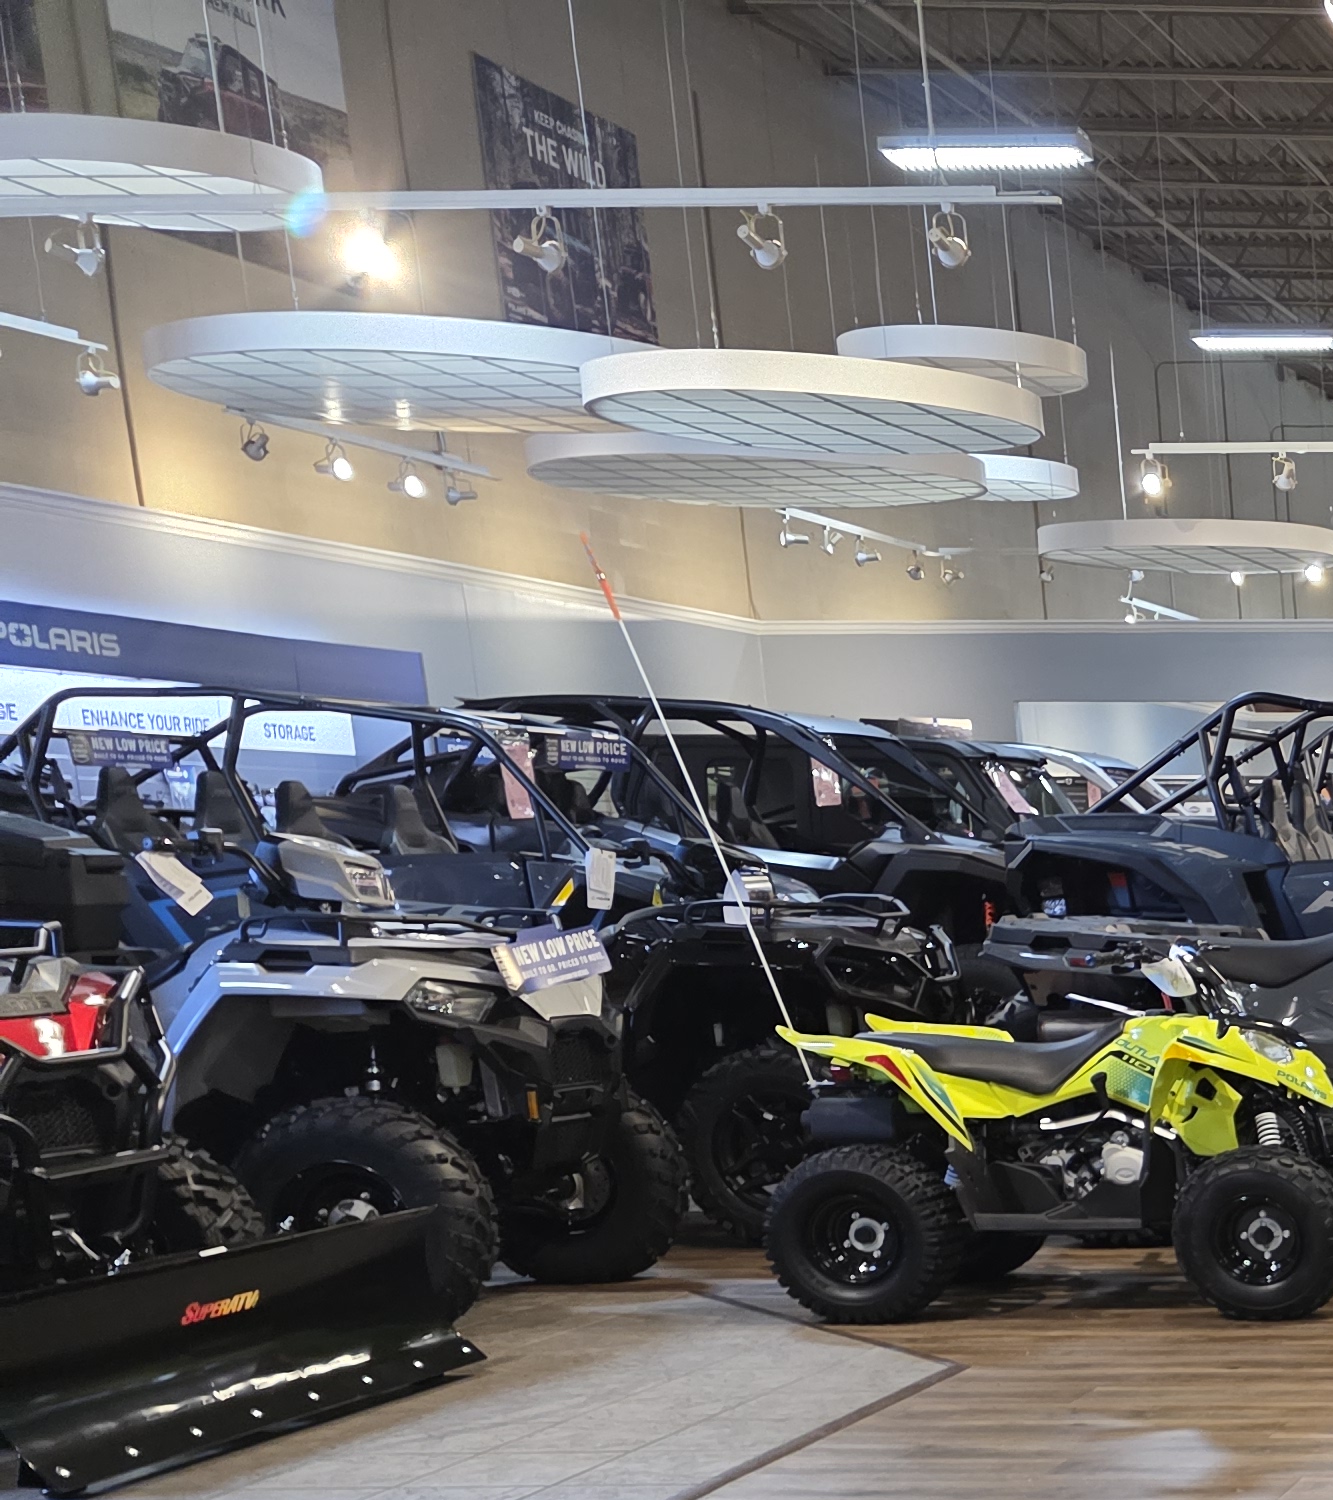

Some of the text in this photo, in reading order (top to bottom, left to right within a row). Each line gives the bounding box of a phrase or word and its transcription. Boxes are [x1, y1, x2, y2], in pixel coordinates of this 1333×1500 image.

[533, 109, 554, 130] KEEP
[522, 126, 607, 189] THE WILD
[82, 708, 210, 735] ENHANCE YOUR RIDE
[263, 722, 316, 742] STORAGE
[91, 736, 168, 754] NEW LOW PRICE
[561, 739, 627, 756] NEW LOW PRICE
[512, 928, 600, 966] NEW LOW PRICE
[558, 957, 579, 971] PRICED
[1115, 1039, 1160, 1064] OUTLA
[1276, 1068, 1328, 1100] POLARIS
